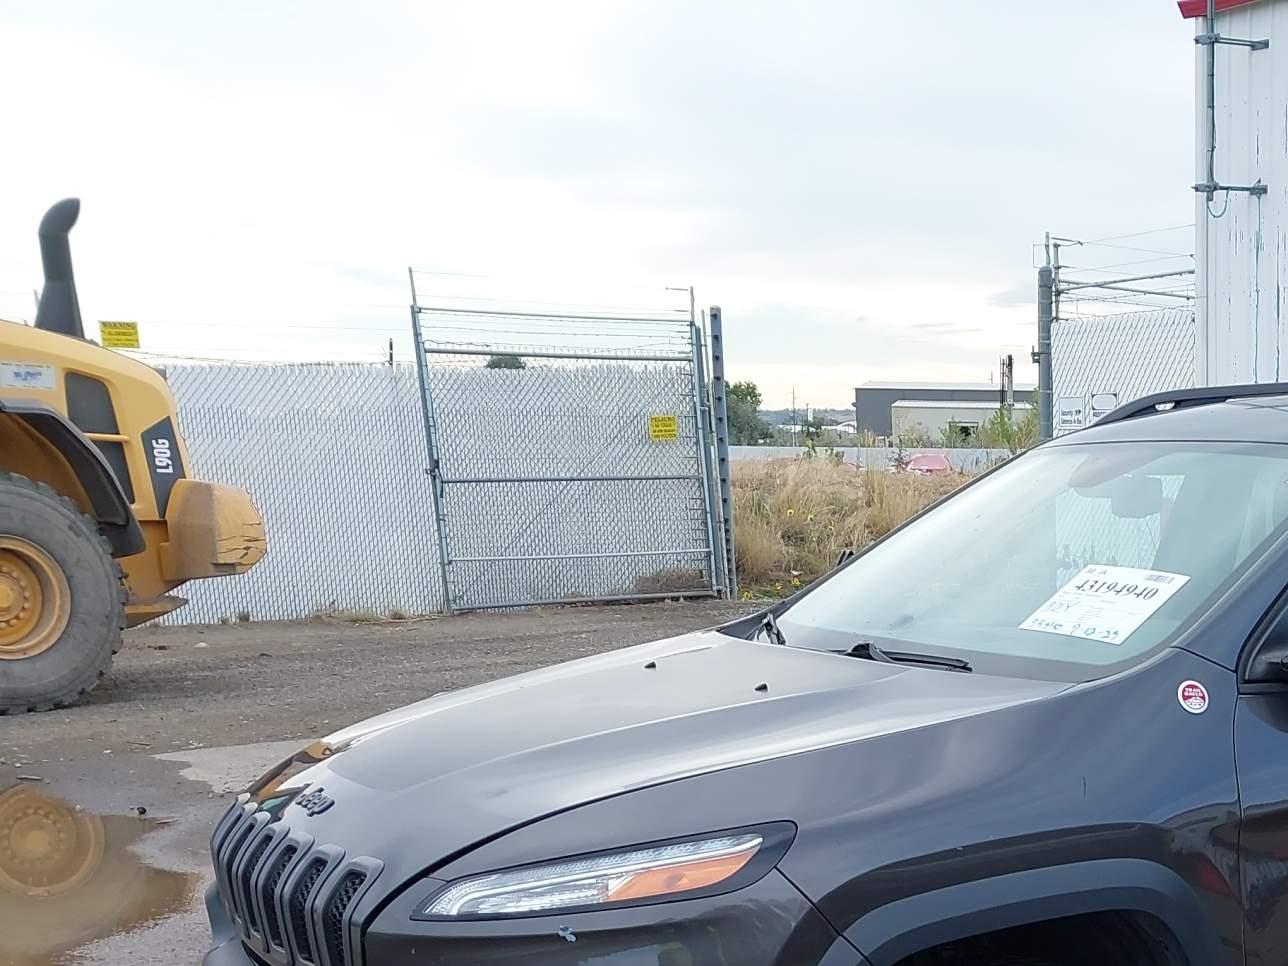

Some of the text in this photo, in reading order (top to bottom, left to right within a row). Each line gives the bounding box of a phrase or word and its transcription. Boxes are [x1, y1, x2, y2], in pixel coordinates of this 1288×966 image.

[152, 438, 174, 473] L90G
[1075, 579, 1159, 600] 43194940
[295, 787, 335, 818] Jeep
